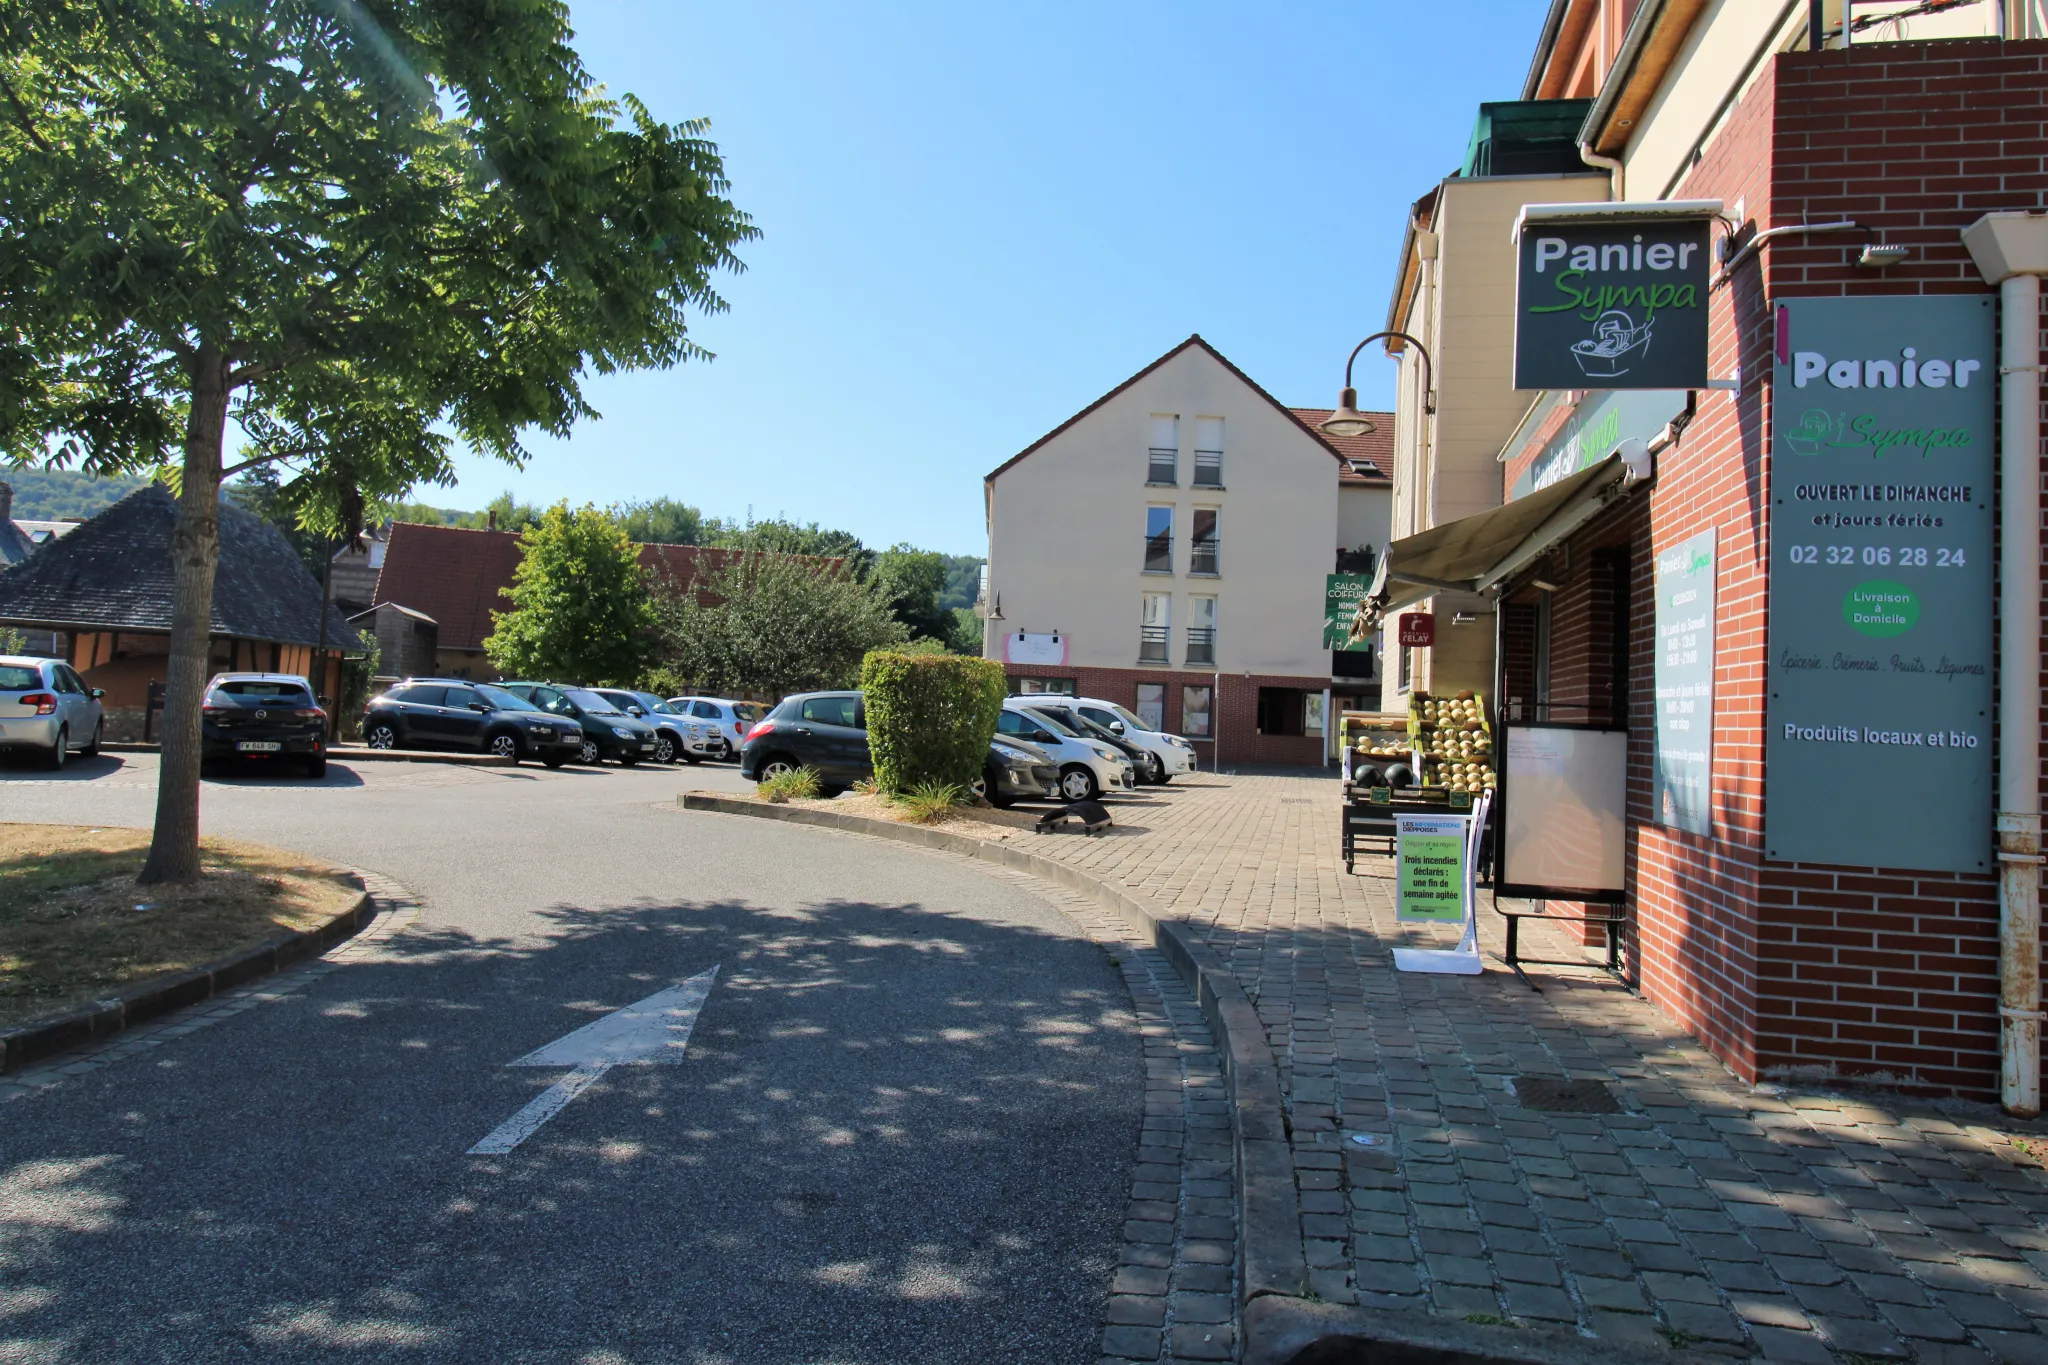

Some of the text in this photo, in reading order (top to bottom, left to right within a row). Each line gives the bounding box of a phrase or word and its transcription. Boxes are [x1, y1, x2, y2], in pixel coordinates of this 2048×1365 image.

[1535, 234, 1698, 273] Panier
[1528, 268, 1698, 322] Sympa
[1793, 346, 1981, 389] Panier
[1826, 413, 1975, 460] Sympa
[1794, 484, 1972, 502] OUVERT LE DIMANCHE
[1812, 512, 1944, 529] et jours fériés
[1790, 545, 1966, 567] 02 32 06 28 24
[1660, 554, 1682, 578] Panier
[1334, 582, 1364, 591] SALON
[1853, 592, 1910, 603] Livraison
[1874, 603, 1882, 613] à
[1853, 613, 1906, 624] Domicile
[1784, 723, 1978, 749] Produits locaux et bio
[1404, 855, 1458, 866] Trois incendies
[1413, 866, 1444, 876] déclarés
[1428, 878, 1438, 887] fin
[1440, 879, 1449, 888] de
[1403, 890, 1458, 901] semaine agitée
